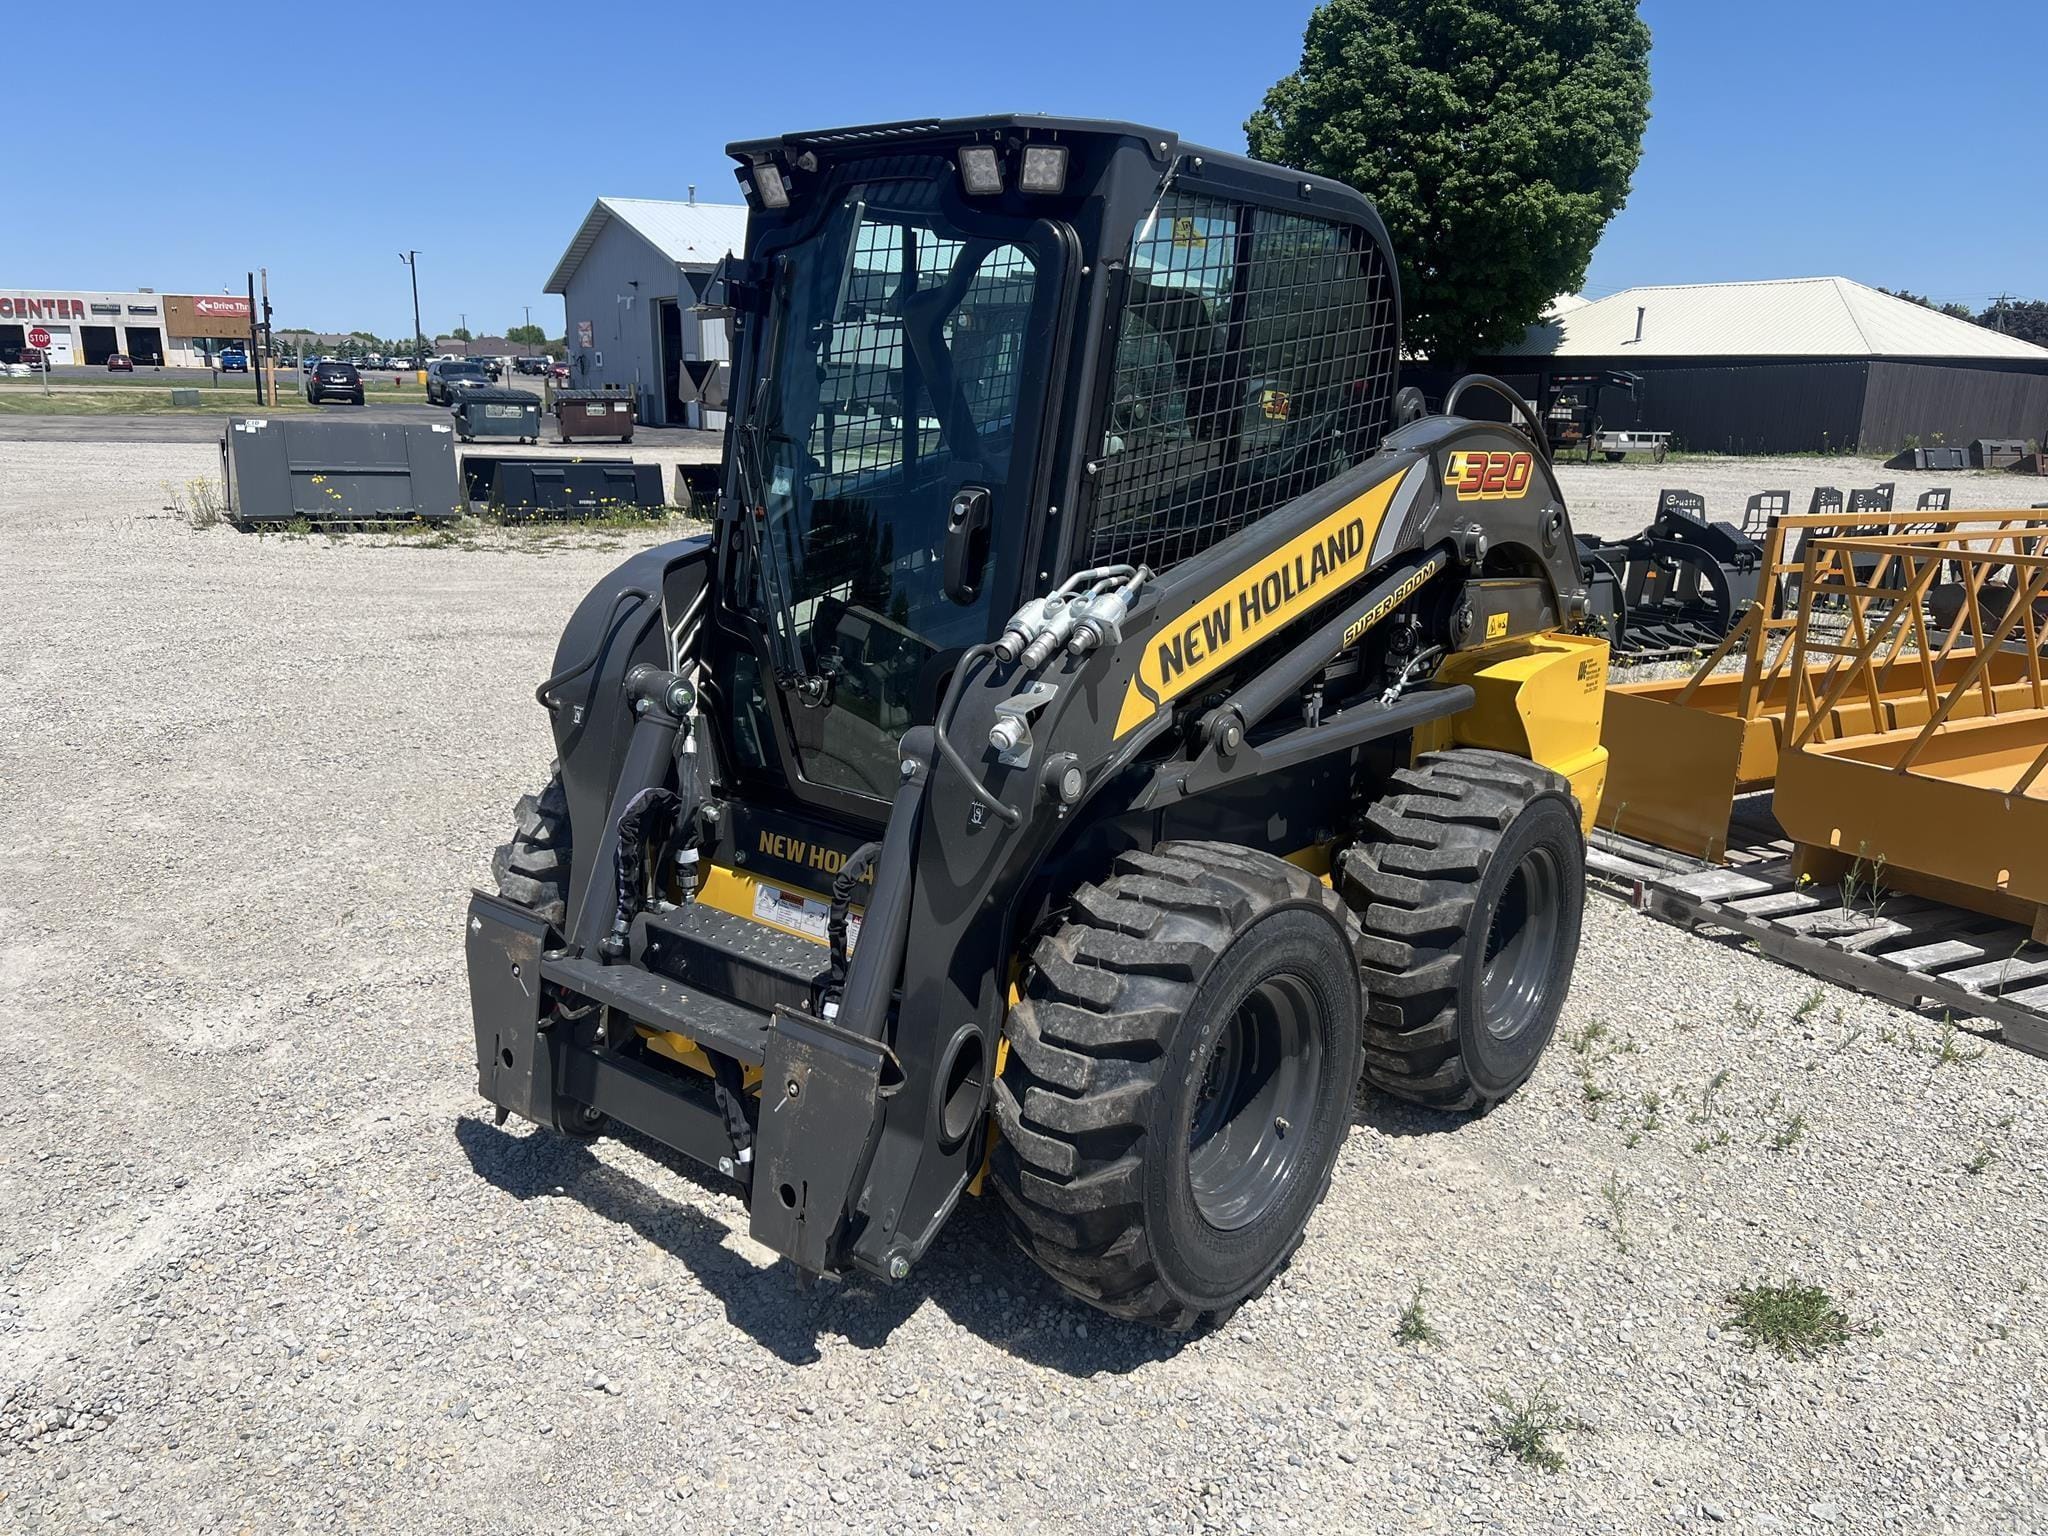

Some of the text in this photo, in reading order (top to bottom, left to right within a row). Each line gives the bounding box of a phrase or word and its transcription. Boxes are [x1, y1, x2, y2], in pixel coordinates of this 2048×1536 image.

[0, 298, 85, 320] CENTER
[213, 301, 234, 310] Drive
[29, 334, 49, 342] STOP
[1445, 452, 1533, 500] L320
[1158, 517, 1365, 685] NEW HOLLAND
[1344, 560, 1436, 647] SUPER BOOM
[759, 830, 806, 863] NEW
